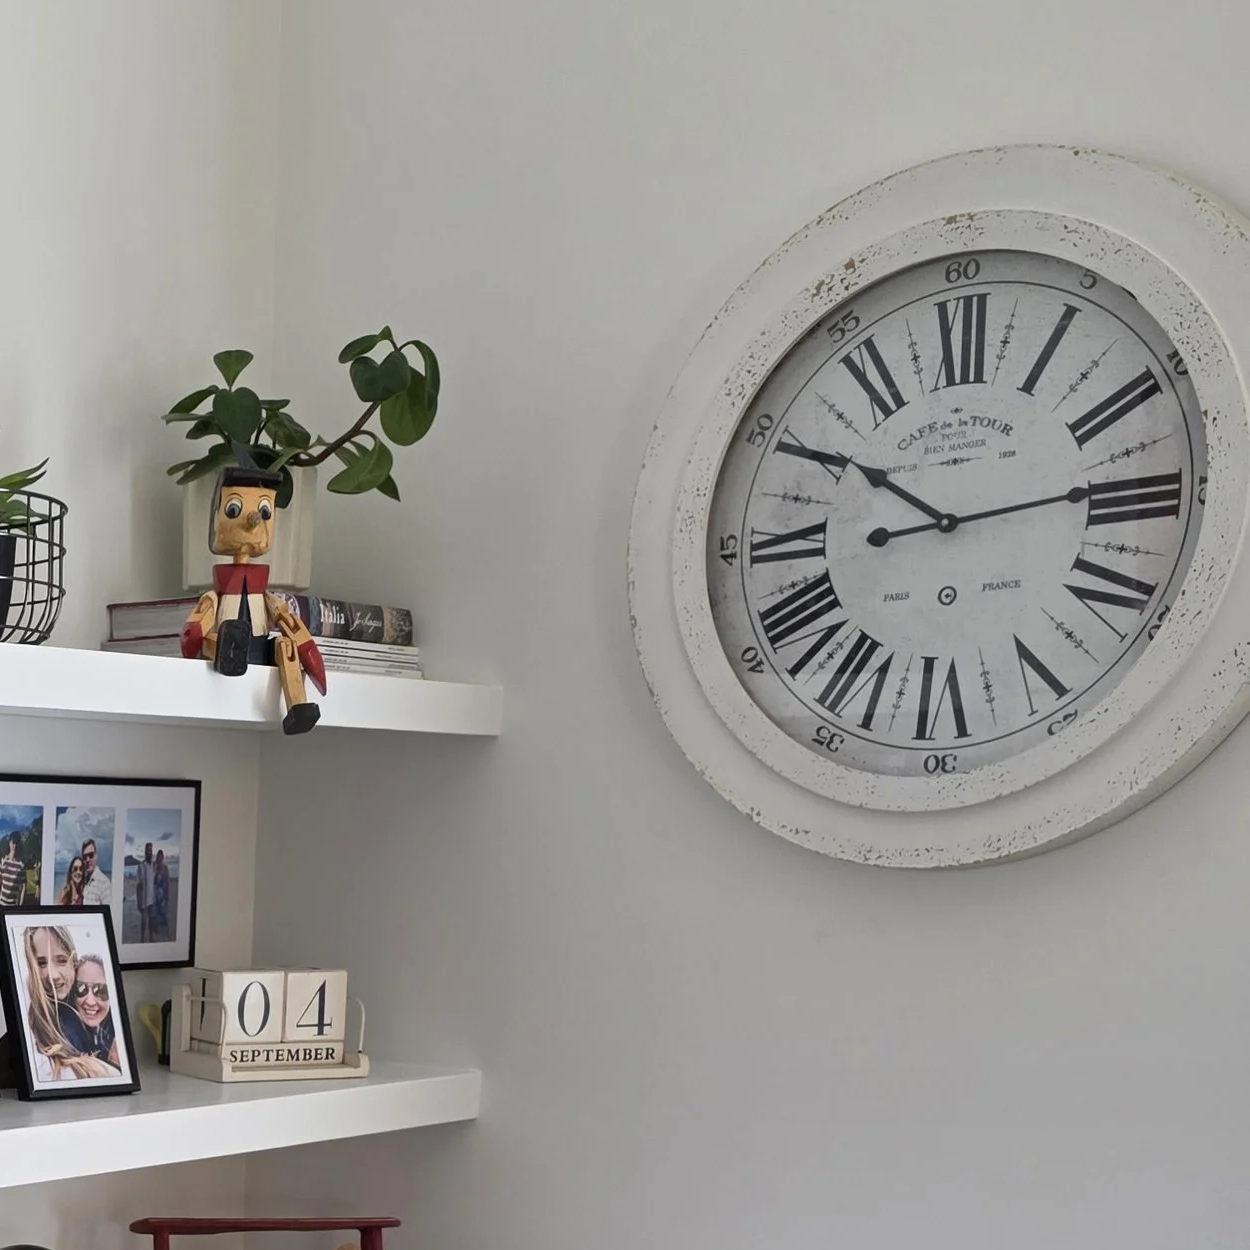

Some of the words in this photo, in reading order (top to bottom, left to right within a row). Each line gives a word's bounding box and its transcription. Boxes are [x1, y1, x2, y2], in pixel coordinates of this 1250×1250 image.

[944, 259, 981, 284] 60
[1079, 269, 1098, 289] 5
[826, 310, 862, 344] 55
[929, 292, 992, 393] XII
[1017, 303, 1082, 396] I
[838, 334, 910, 431] XI
[1065, 365, 1163, 451] II
[746, 413, 774, 448] 50
[897, 421, 939, 451] CAFE
[940, 421, 953, 431] de
[970, 416, 1014, 437] TOUR
[923, 444, 945, 455] BIEN
[947, 439, 987, 452] MANGER
[941, 431, 967, 442] POUR
[772, 425, 853, 484] X
[886, 464, 918, 475] DEPUIS
[1085, 468, 1182, 530] III
[720, 534, 738, 567] 45
[751, 517, 827, 568] IX
[883, 592, 910, 603] PARIS
[982, 580, 1022, 592] FRANCE
[319, 603, 346, 625] Italia
[758, 568, 850, 681] VIII
[741, 646, 764, 675] 40
[1013, 633, 1073, 717] V
[813, 629, 894, 731] VII
[911, 656, 972, 740] VI
[812, 725, 845, 752] 35
[923, 753, 957, 775] 30
[229, 1047, 336, 1064] SEPTEMBER
